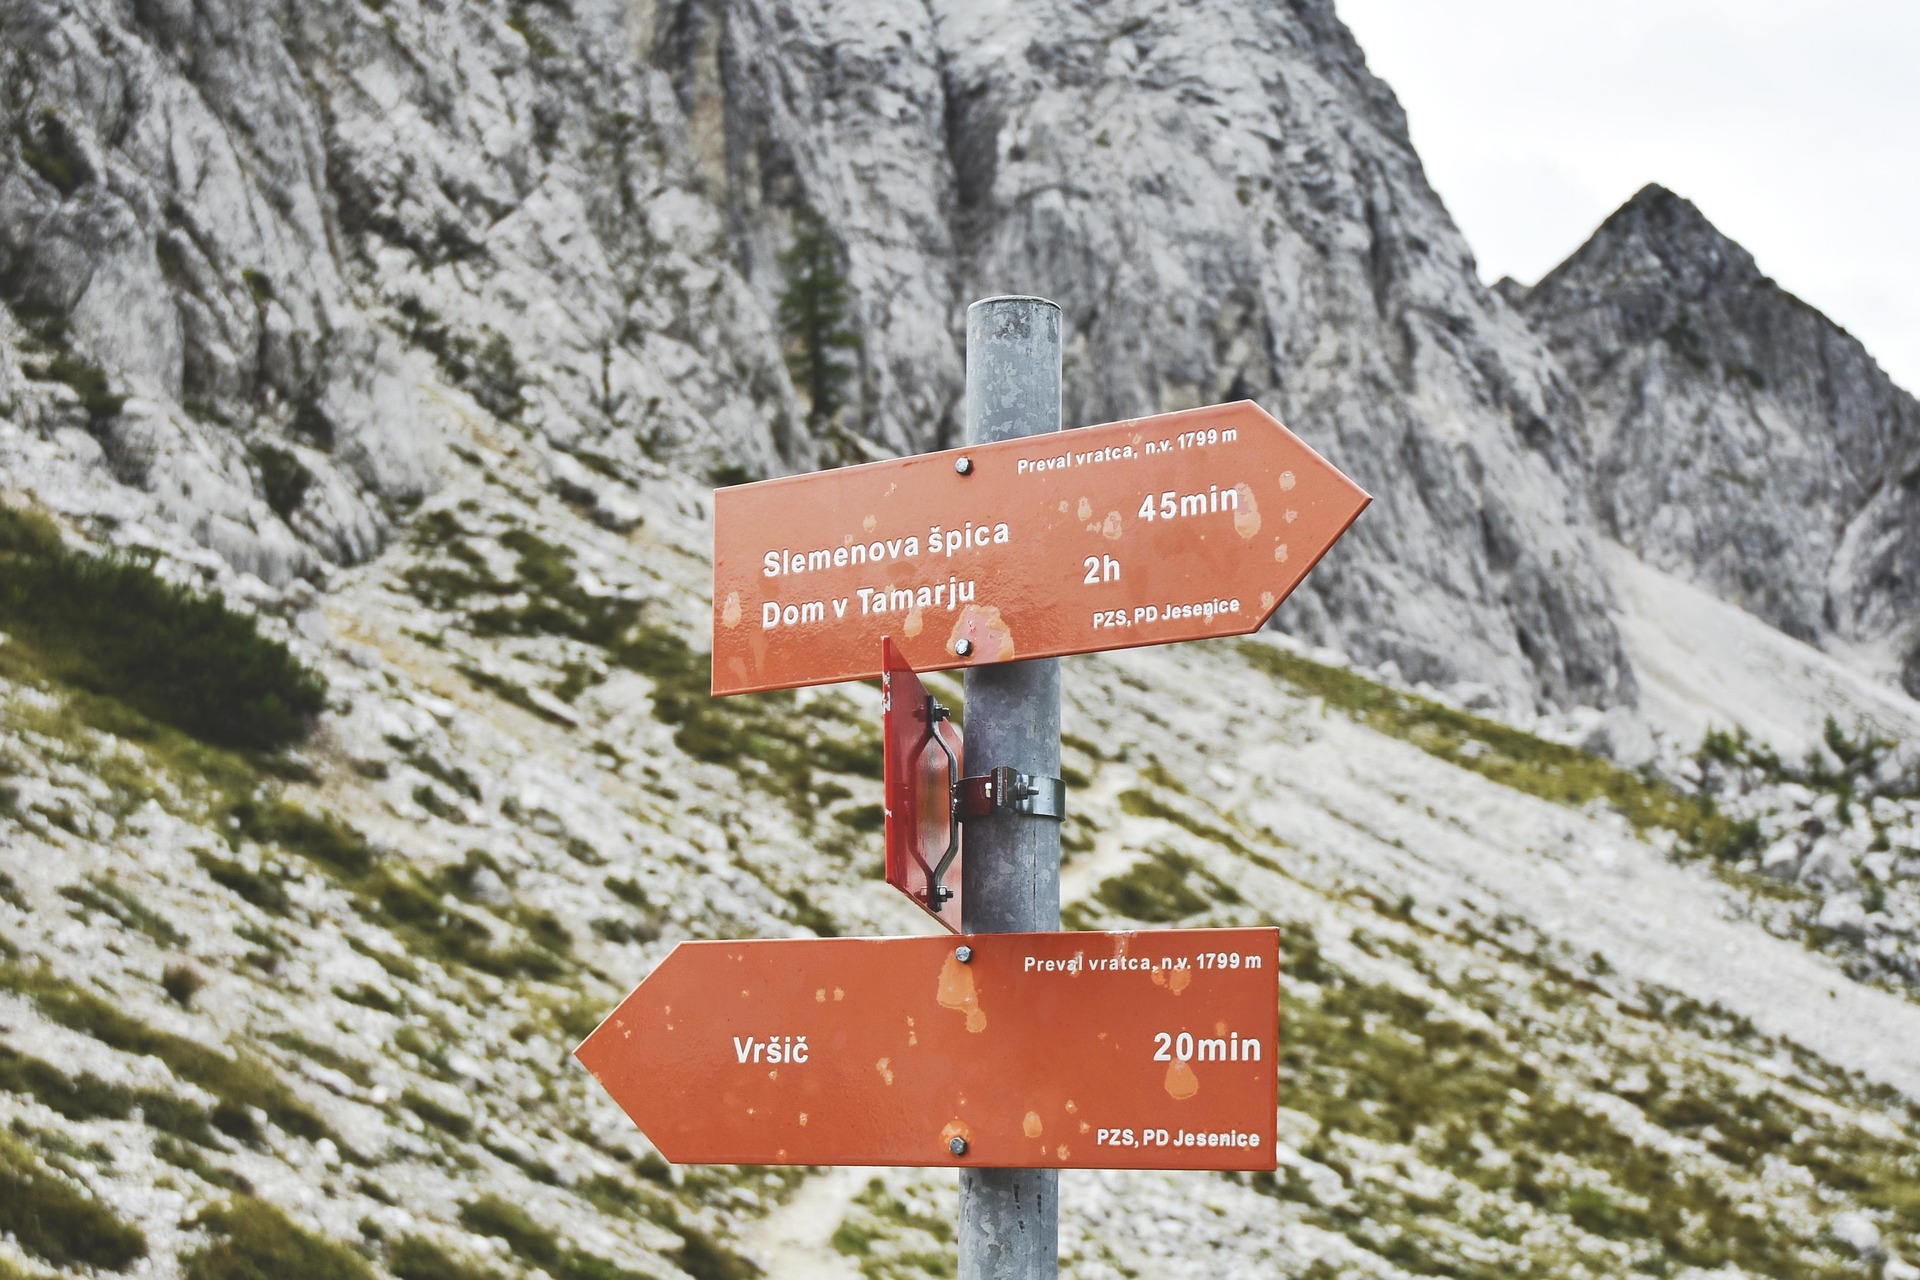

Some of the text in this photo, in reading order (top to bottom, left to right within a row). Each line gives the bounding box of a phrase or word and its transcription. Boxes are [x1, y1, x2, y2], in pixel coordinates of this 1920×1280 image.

[1017, 427, 1238, 475] Preval vratca, n.v. 1799 m
[1137, 484, 1240, 523] 45min
[763, 520, 1011, 577] Slemenova špica
[1083, 554, 1121, 585] 2h
[760, 577, 976, 630] Dom v Tamarju
[1093, 598, 1241, 631] PZS, PD Jesenice
[1024, 952, 1262, 974] Preval vratca, n.v. 1799 m
[733, 1035, 809, 1064] Vršič
[1153, 1031, 1261, 1062] 20min
[1097, 1128, 1261, 1149] PZS, PD Jesenice
